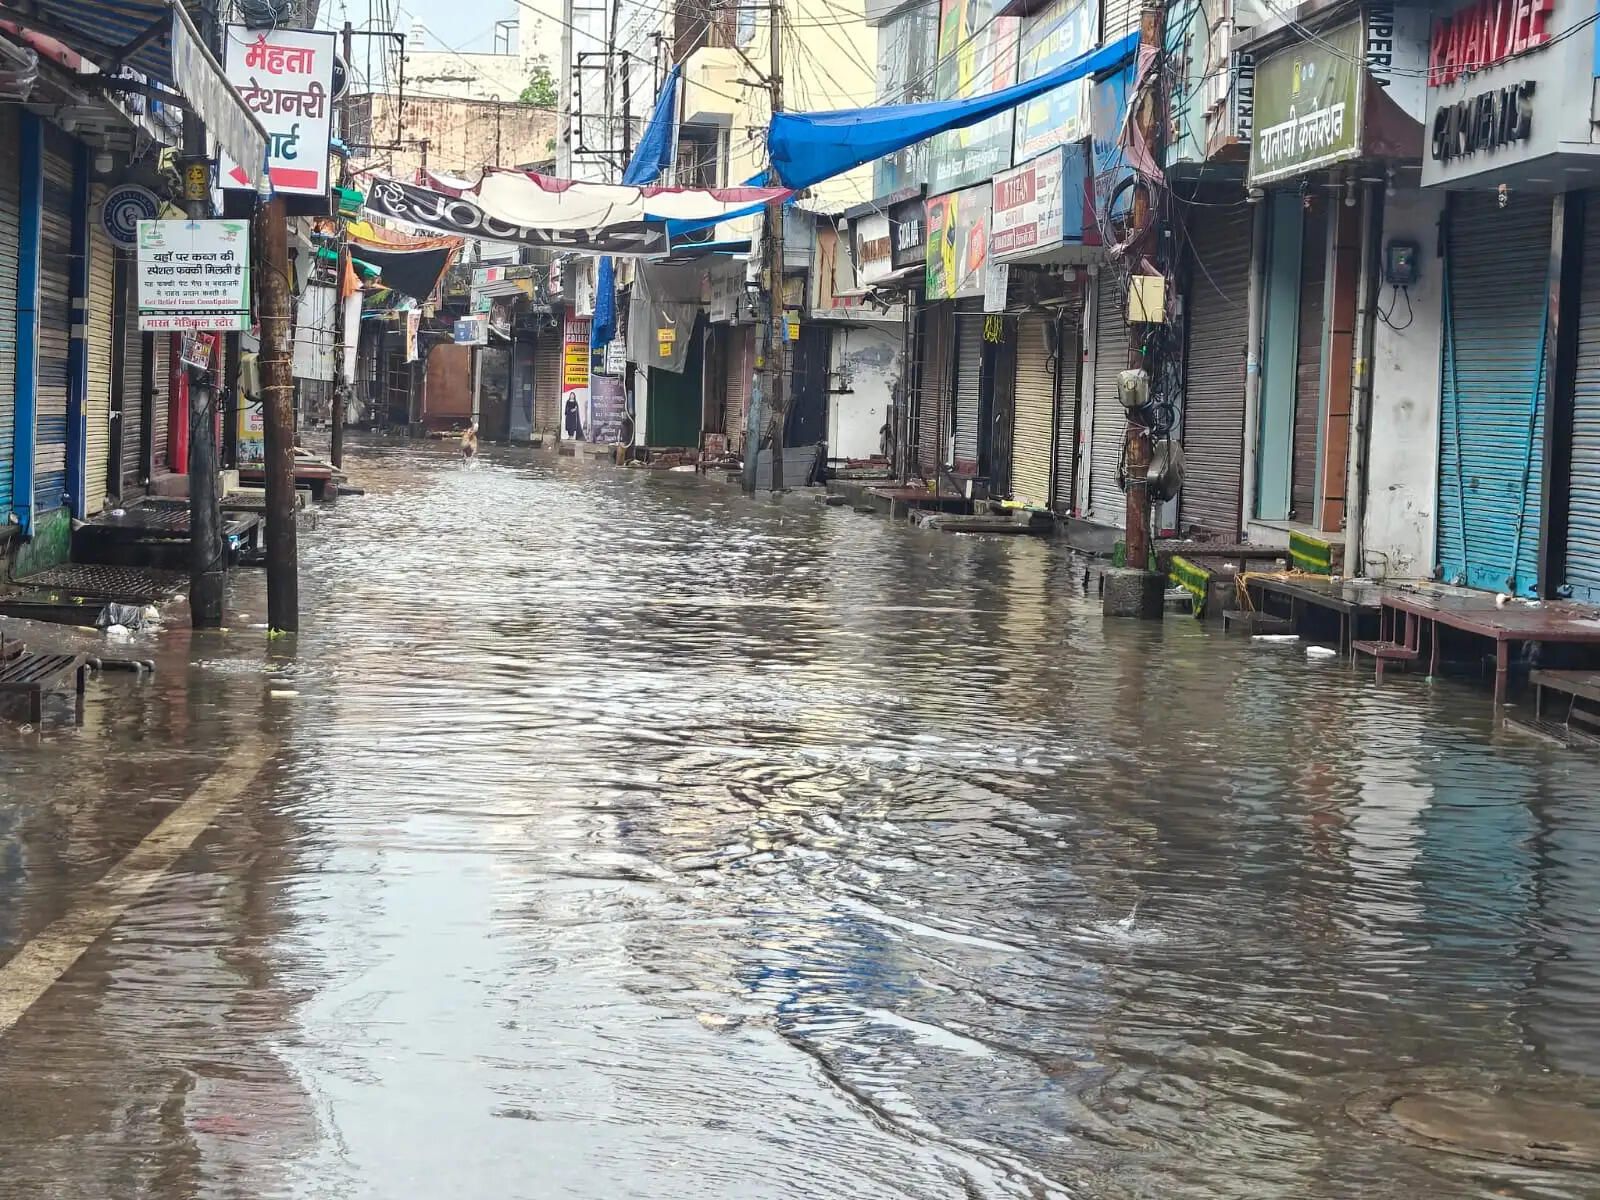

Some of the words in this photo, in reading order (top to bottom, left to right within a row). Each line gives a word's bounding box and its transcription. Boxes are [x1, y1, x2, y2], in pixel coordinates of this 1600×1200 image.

[246, 33, 315, 74] मेहता
[234, 76, 327, 119] टेशनरी
[1260, 104, 1298, 165] बालाजी
[147, 265, 175, 275] स्पेशल
[176, 263, 202, 275] फक्की
[205, 263, 232, 275] मिलती
[234, 263, 241, 275] है
[176, 253, 189, 261] पर
[191, 253, 217, 261] कब्ज
[220, 250, 234, 261] की
